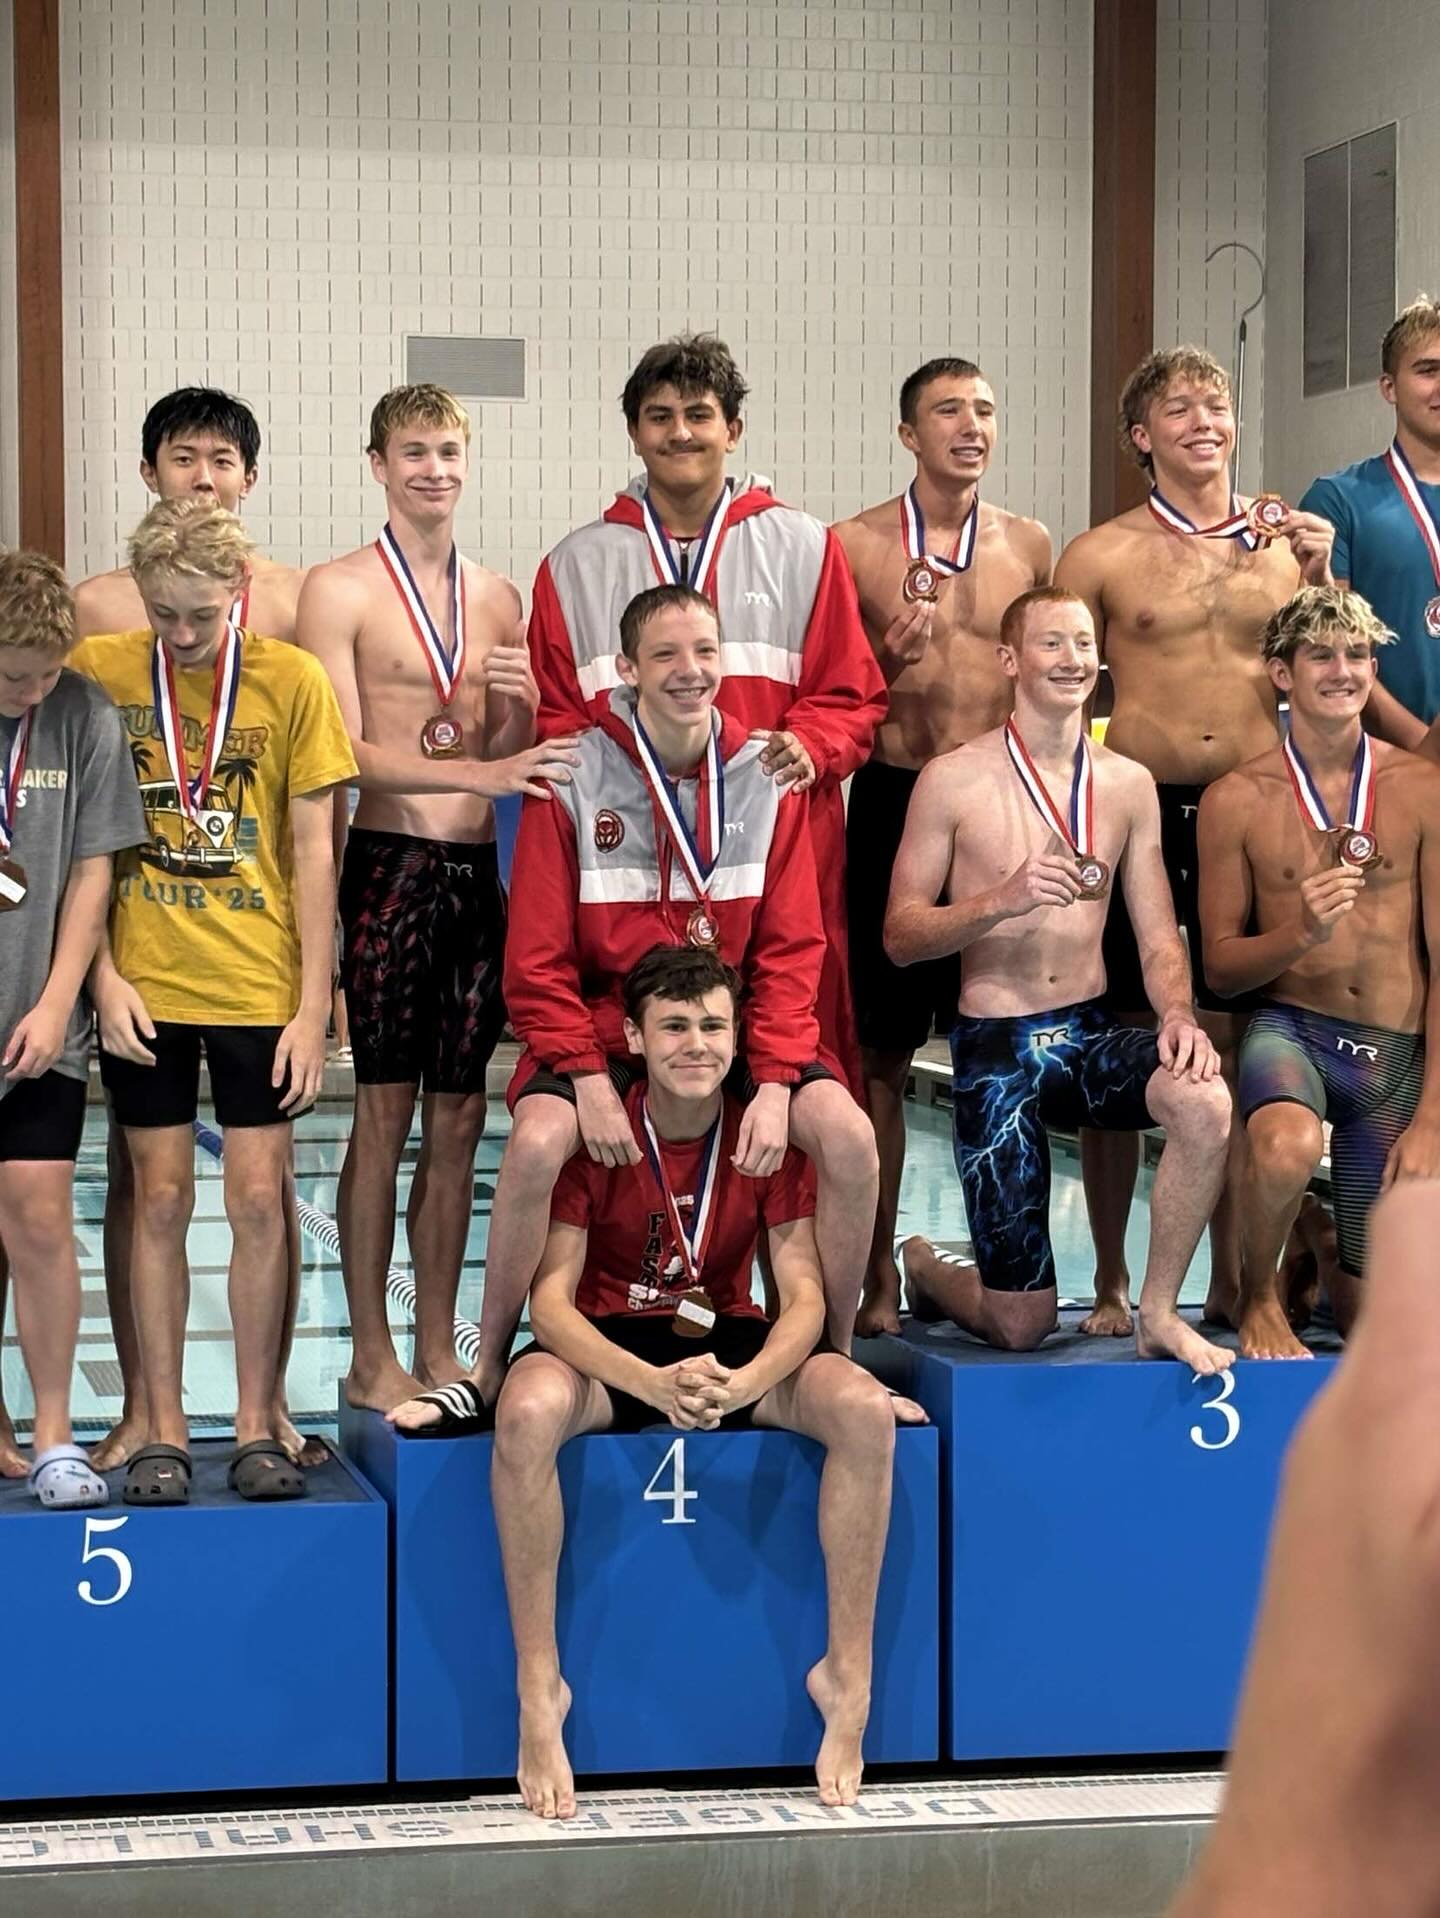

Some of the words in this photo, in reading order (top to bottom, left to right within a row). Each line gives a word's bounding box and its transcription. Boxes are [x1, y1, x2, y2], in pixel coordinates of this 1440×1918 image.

[745, 591, 770, 607] TYR
[116, 704, 269, 761] UMER
[0, 768, 67, 789] AKER
[724, 822, 744, 836] TYR
[444, 862, 473, 878] TYR
[1032, 1028, 1070, 1046] TYR
[1337, 1036, 1378, 1061] TYR
[638, 1210, 667, 1289] FAST
[1190, 1370, 1240, 1449] 3
[642, 1438, 699, 1526] 4
[77, 1515, 133, 1606] 5
[548, 1798, 996, 1831] DANGER
